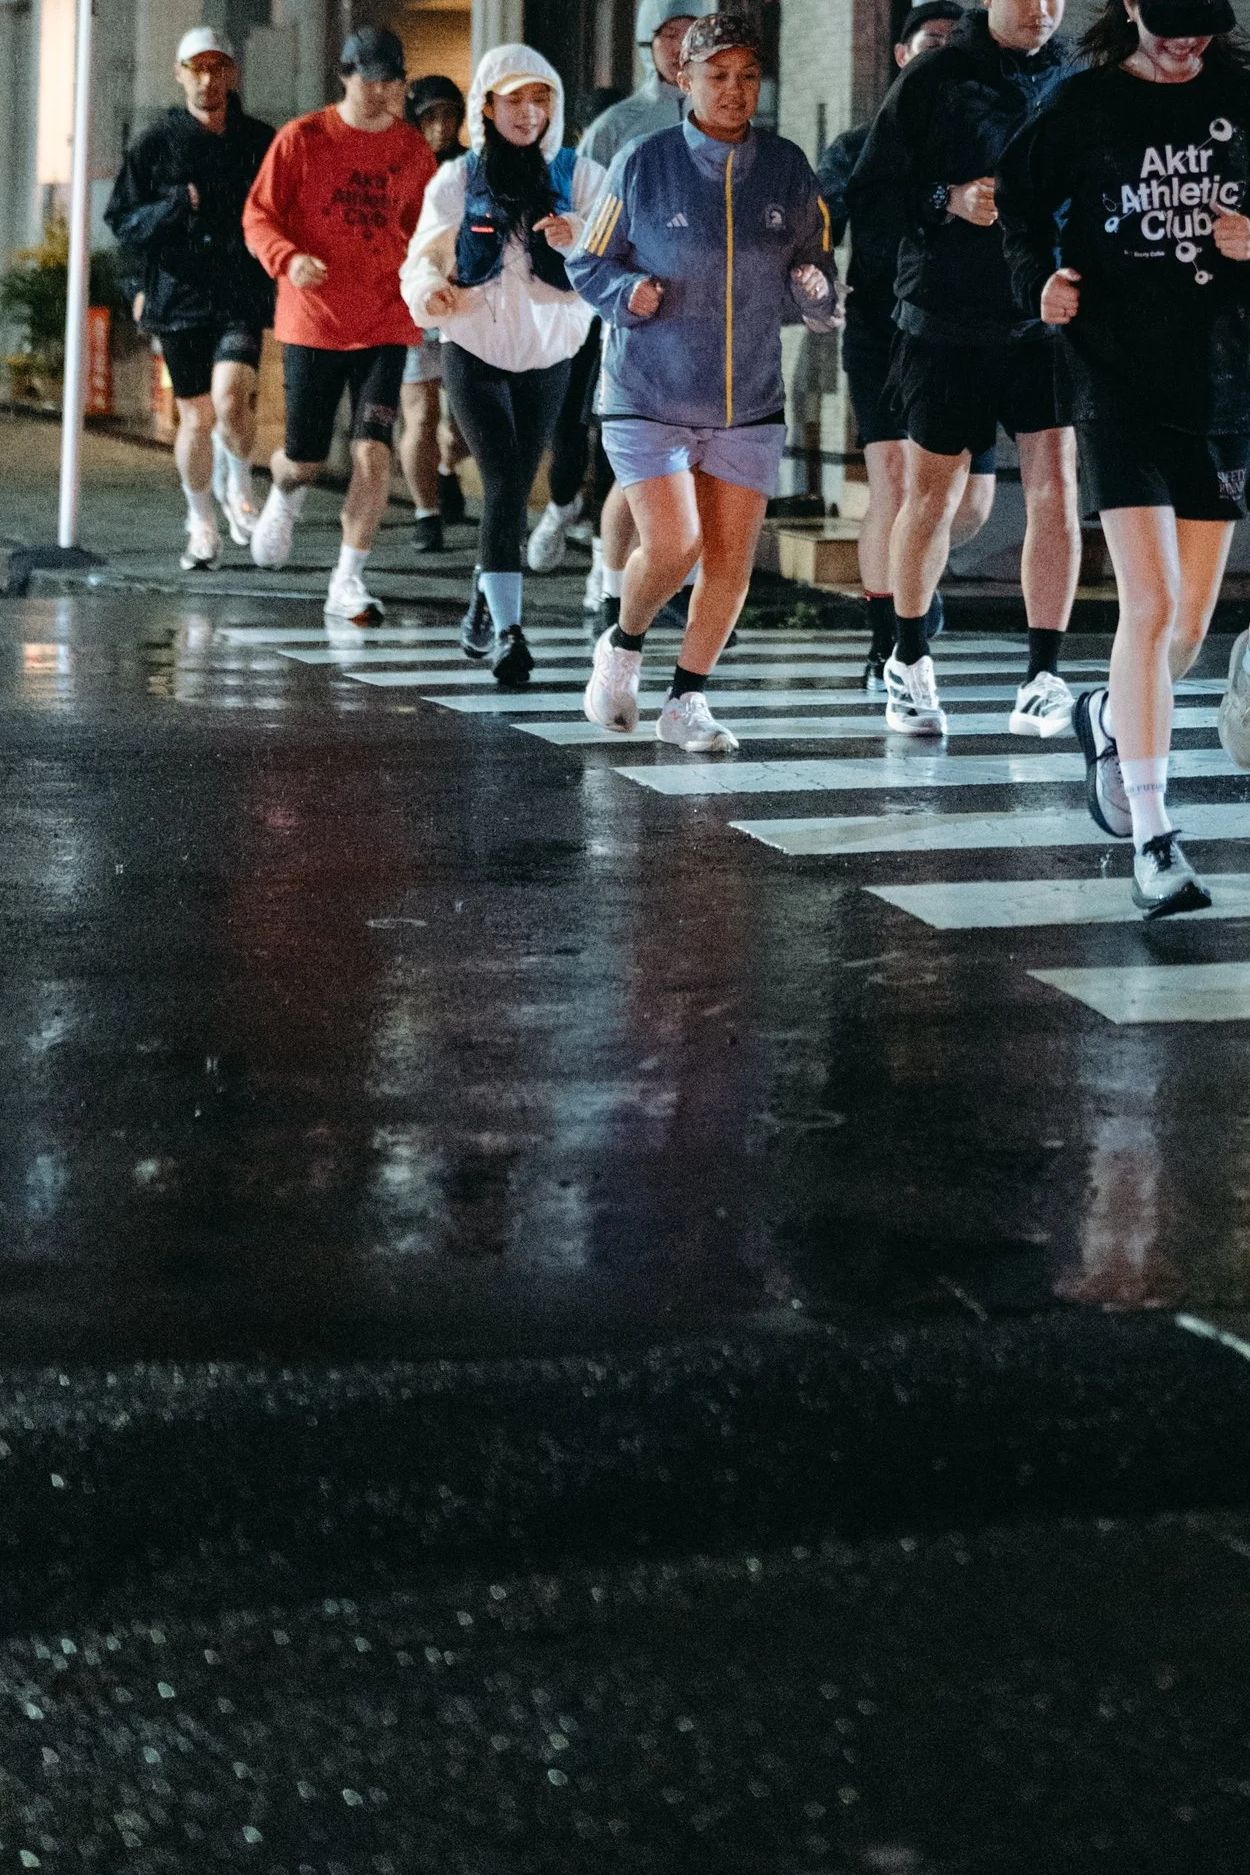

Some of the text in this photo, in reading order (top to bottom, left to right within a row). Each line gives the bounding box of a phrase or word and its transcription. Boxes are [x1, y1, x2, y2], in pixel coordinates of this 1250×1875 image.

[1140, 143, 1213, 178] Aktr
[1121, 175, 1239, 214] Athletic
[1140, 207, 1213, 241] Club
